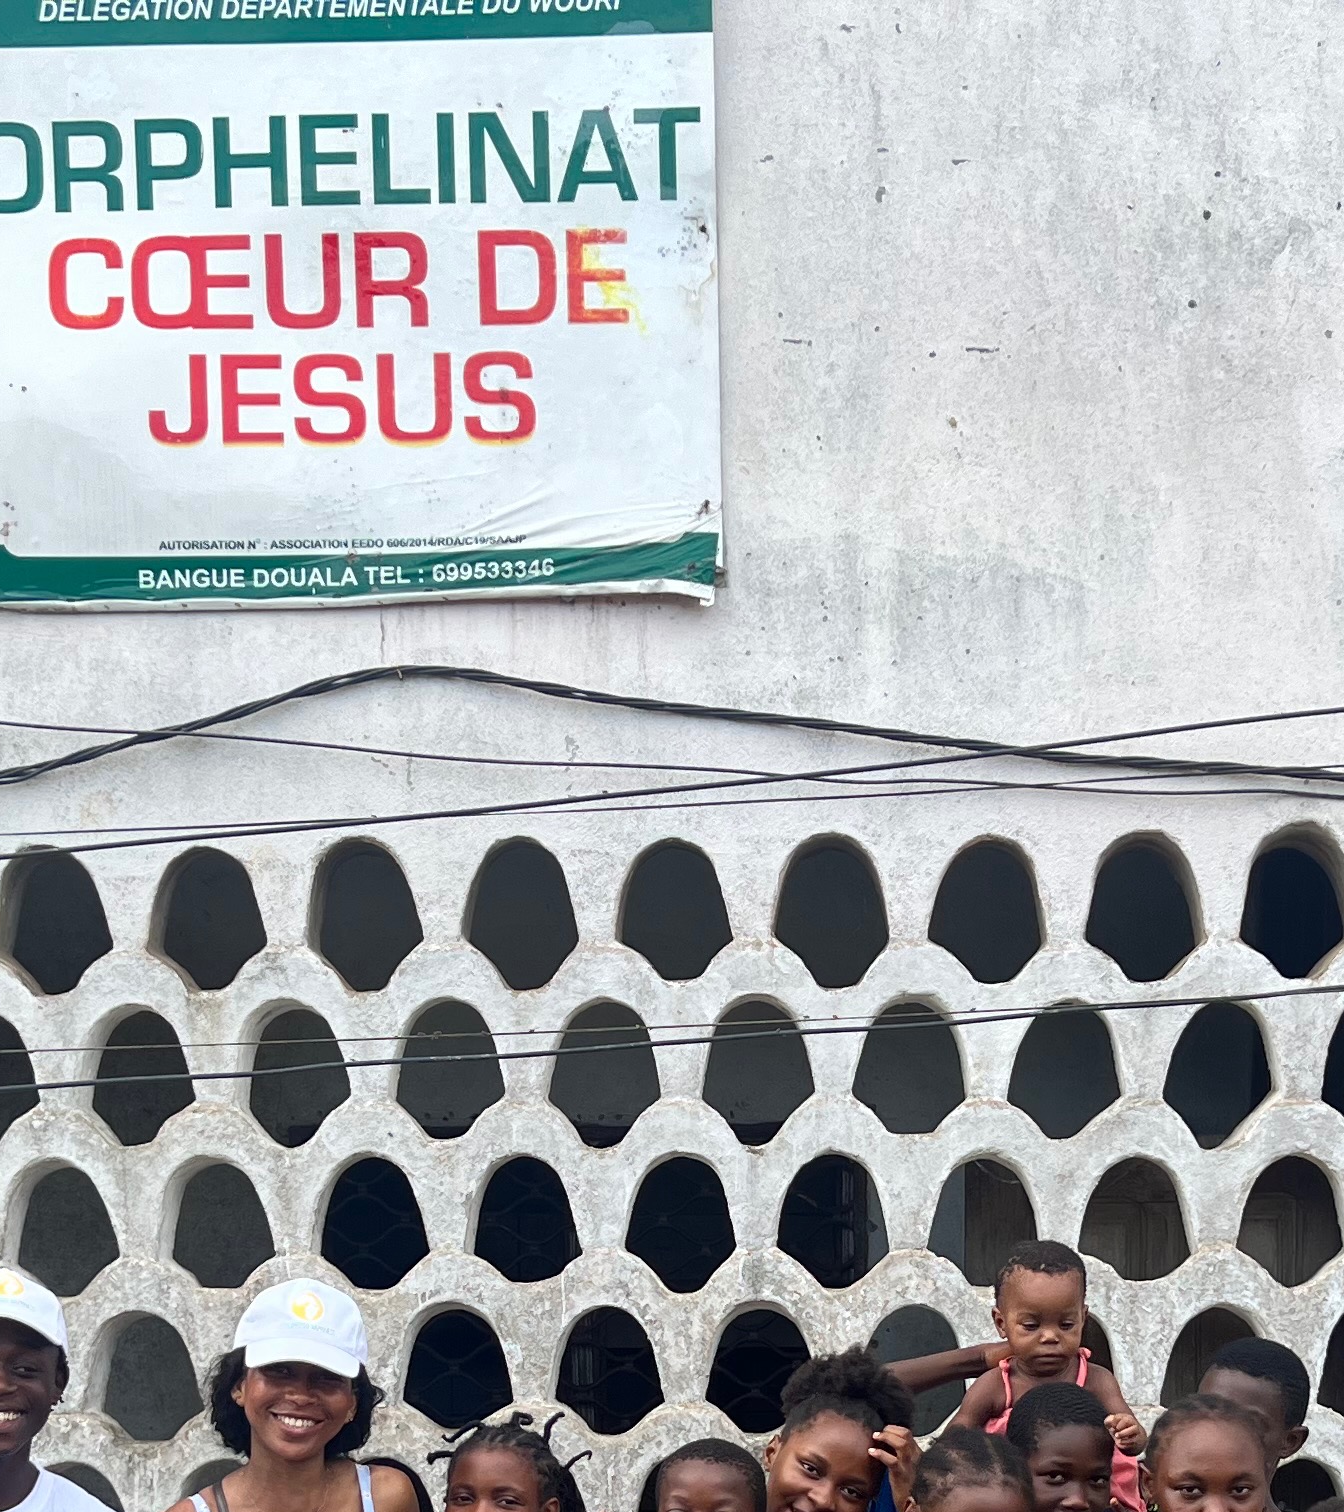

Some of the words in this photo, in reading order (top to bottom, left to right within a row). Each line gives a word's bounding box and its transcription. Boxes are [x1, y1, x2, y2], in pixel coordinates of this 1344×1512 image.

[38, 0, 213, 22] DELEGATION
[220, 0, 474, 20] DEPARTEMENTALE
[481, 0, 522, 14] DU
[47, 231, 429, 330] CŒUR
[476, 228, 630, 327] DE
[148, 351, 538, 447] JESUS
[158, 540, 245, 551] AUTORISATION
[270, 538, 349, 550] ASSOCIATION
[138, 568, 246, 590] BANGUE
[253, 566, 359, 589] DOUALA
[363, 565, 411, 586] TEL
[432, 557, 556, 583] 699533346
